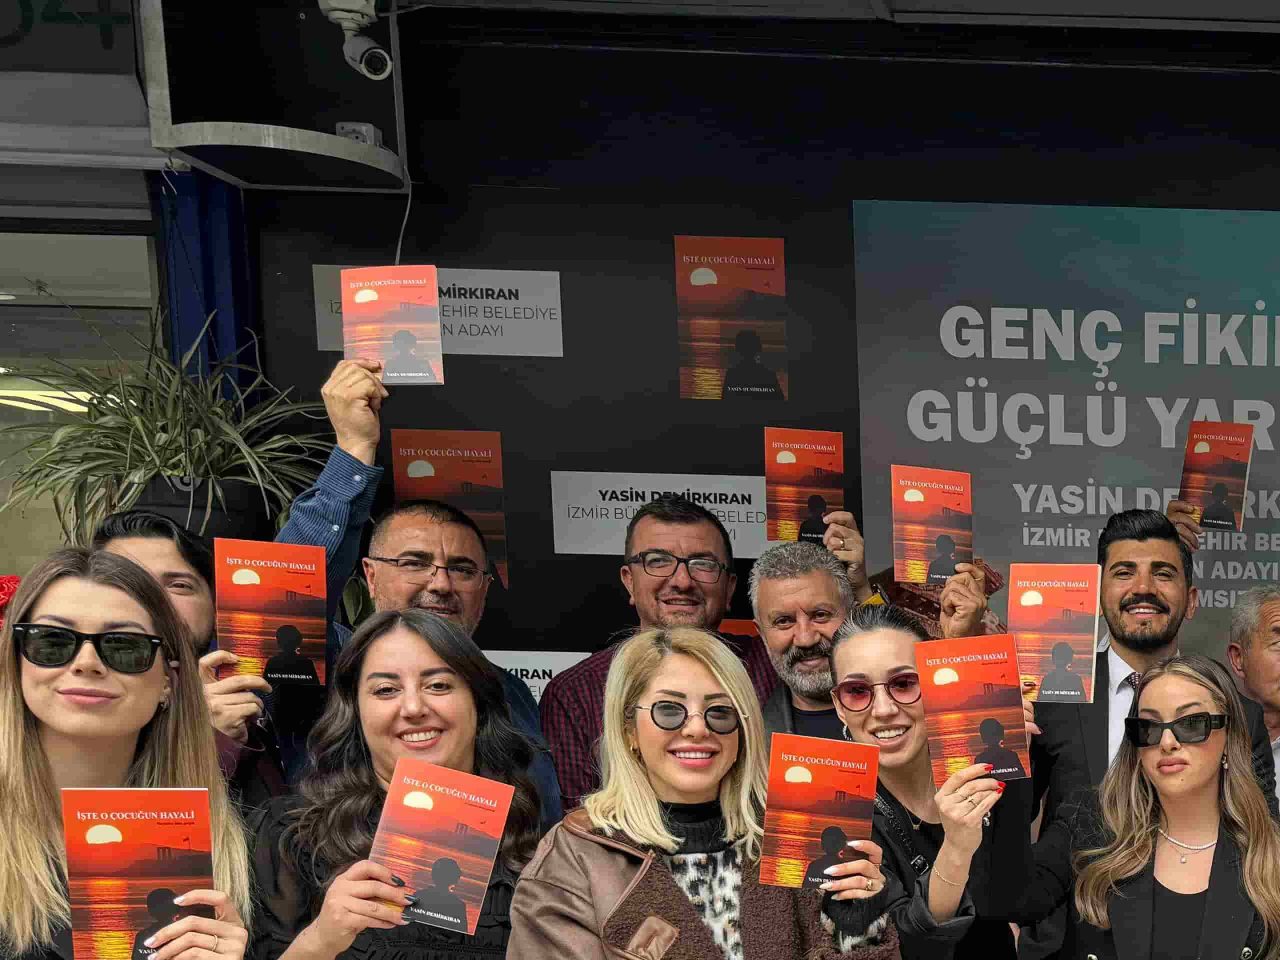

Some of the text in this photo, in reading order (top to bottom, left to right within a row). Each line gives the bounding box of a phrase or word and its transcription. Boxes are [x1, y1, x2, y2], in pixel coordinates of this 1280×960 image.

[438, 284, 520, 301] MİRKIRAN
[483, 303, 557, 321] BELEDİYE
[458, 323, 503, 337] ADAYI
[940, 306, 1122, 377] GENÇ
[907, 377, 1127, 459] GÜÇLÜ
[599, 487, 645, 502] YASİN
[1013, 478, 1123, 514] YASİN
[567, 504, 609, 520] İZMİR
[716, 510, 766, 524] BELED
[1023, 522, 1089, 547] İZMİR
[1212, 561, 1279, 581] ADAYI
[782, 752, 797, 762] İŞTE
[806, 757, 841, 767] ÇOCUĞUN
[843, 761, 867, 770] HAYALİ
[422, 781, 428, 789] O
[77, 811, 99, 821] İŞTE
[111, 811, 157, 821] ÇOCUĞUN
[160, 811, 194, 819] HAYALİ
